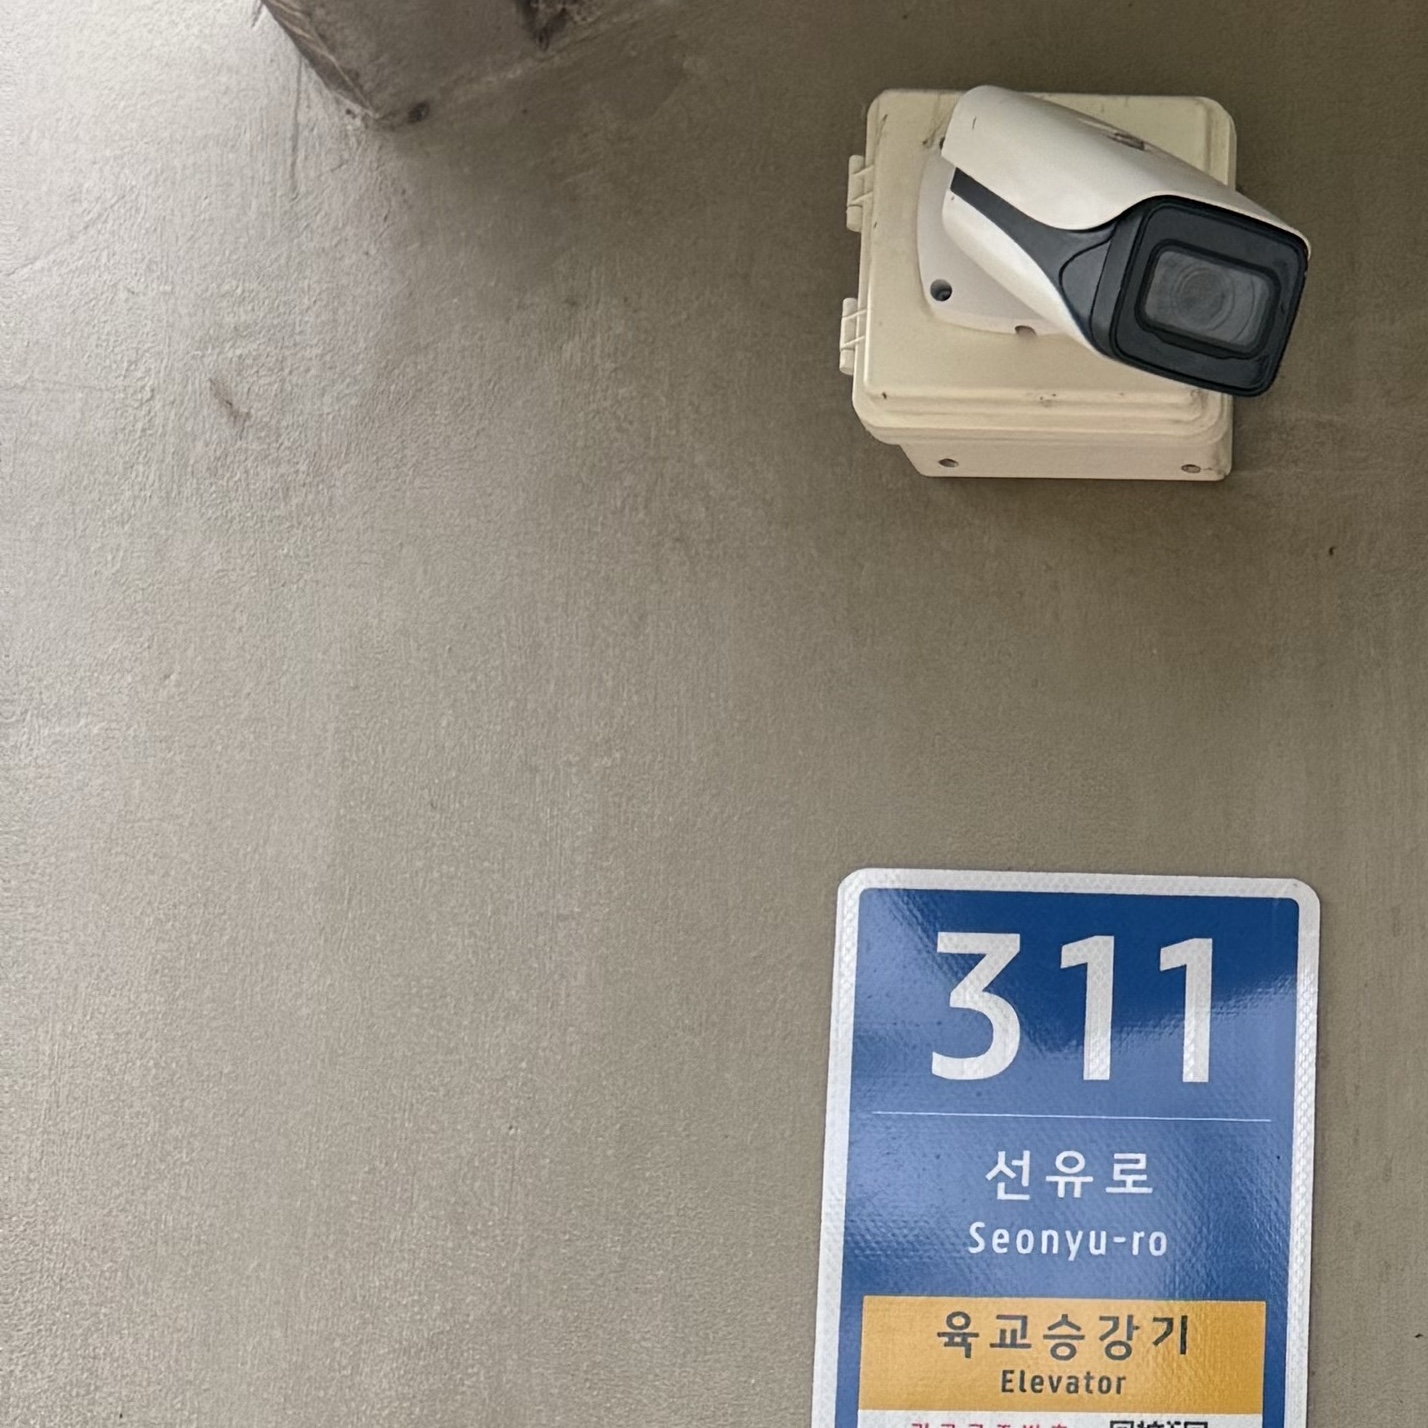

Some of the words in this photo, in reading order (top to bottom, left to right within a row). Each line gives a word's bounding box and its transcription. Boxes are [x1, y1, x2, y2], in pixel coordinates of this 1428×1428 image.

[930, 931, 1213, 1083] 311
[985, 1150, 1154, 1201] 선유로
[968, 1221, 1168, 1260] Seonyu-ro
[937, 1310, 1190, 1358] 육교승강기
[1000, 1368, 1127, 1397] Elevator
